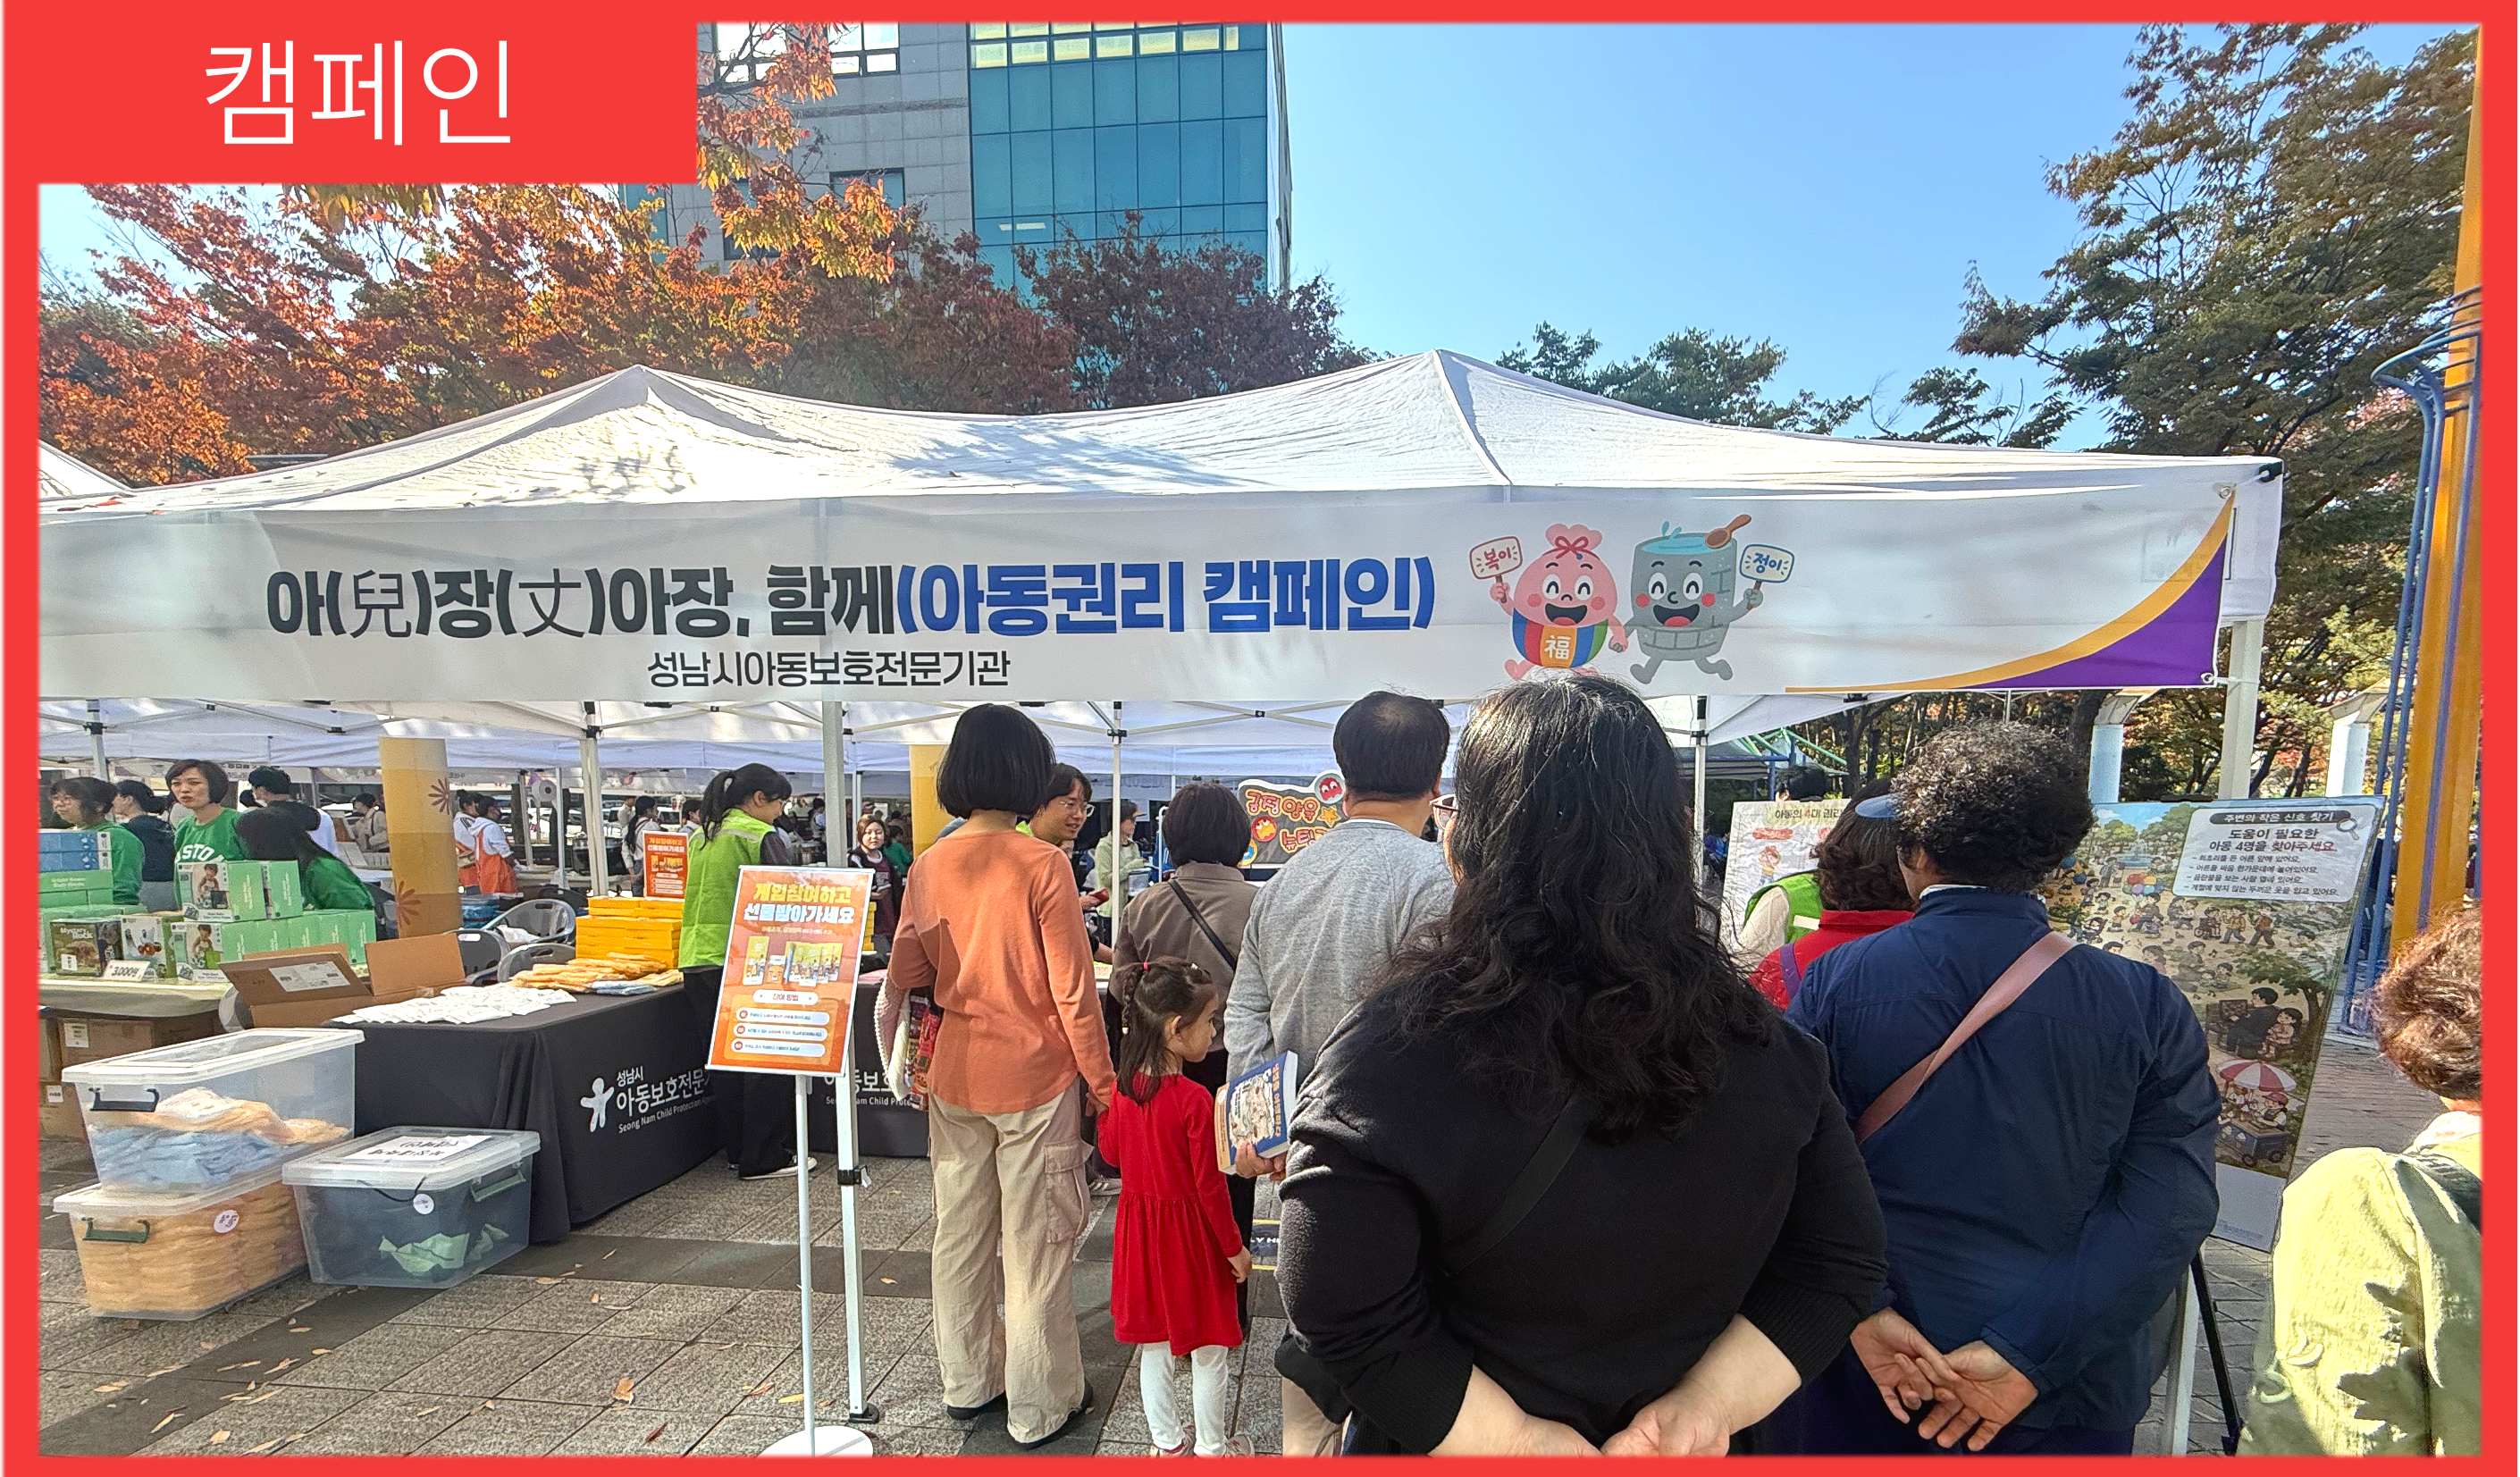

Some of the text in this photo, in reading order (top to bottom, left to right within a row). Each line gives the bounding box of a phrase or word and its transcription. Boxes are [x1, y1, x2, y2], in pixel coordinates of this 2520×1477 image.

[1483, 547, 1512, 571] 복이
[1753, 552, 1783, 574] 정이
[267, 567, 750, 639] 아(兒)장(丈)아장,
[1203, 556, 1435, 633] 캠페인)
[1544, 634, 1572, 659] 福
[647, 650, 1012, 688] 성남시아동보호전문기관
[1775, 809, 1802, 819] 아동의
[1805, 809, 1821, 819] 4대
[2223, 812, 2334, 823] 주변의 작은 신호 찾기
[2228, 827, 2320, 840] 도움이 필요한
[2209, 840, 2338, 852] 아동 4명을 찾아주세요.
[2239, 854, 2255, 863] 어른
[2224, 874, 2239, 883] 보는
[2241, 875, 2258, 883] 사람
[753, 883, 853, 904] 게임참여하고
[2293, 886, 2310, 895] 입고
[743, 902, 855, 925] 선물받아가세요
[617, 1065, 644, 1087] 성남시
[869, 1096, 889, 1106] Child
[890, 1096, 911, 1107] Prote
[618, 1119, 641, 1134] Seong
[641, 1114, 656, 1126] Nam
[656, 1107, 673, 1120] Child
[673, 1099, 701, 1114] Protection
